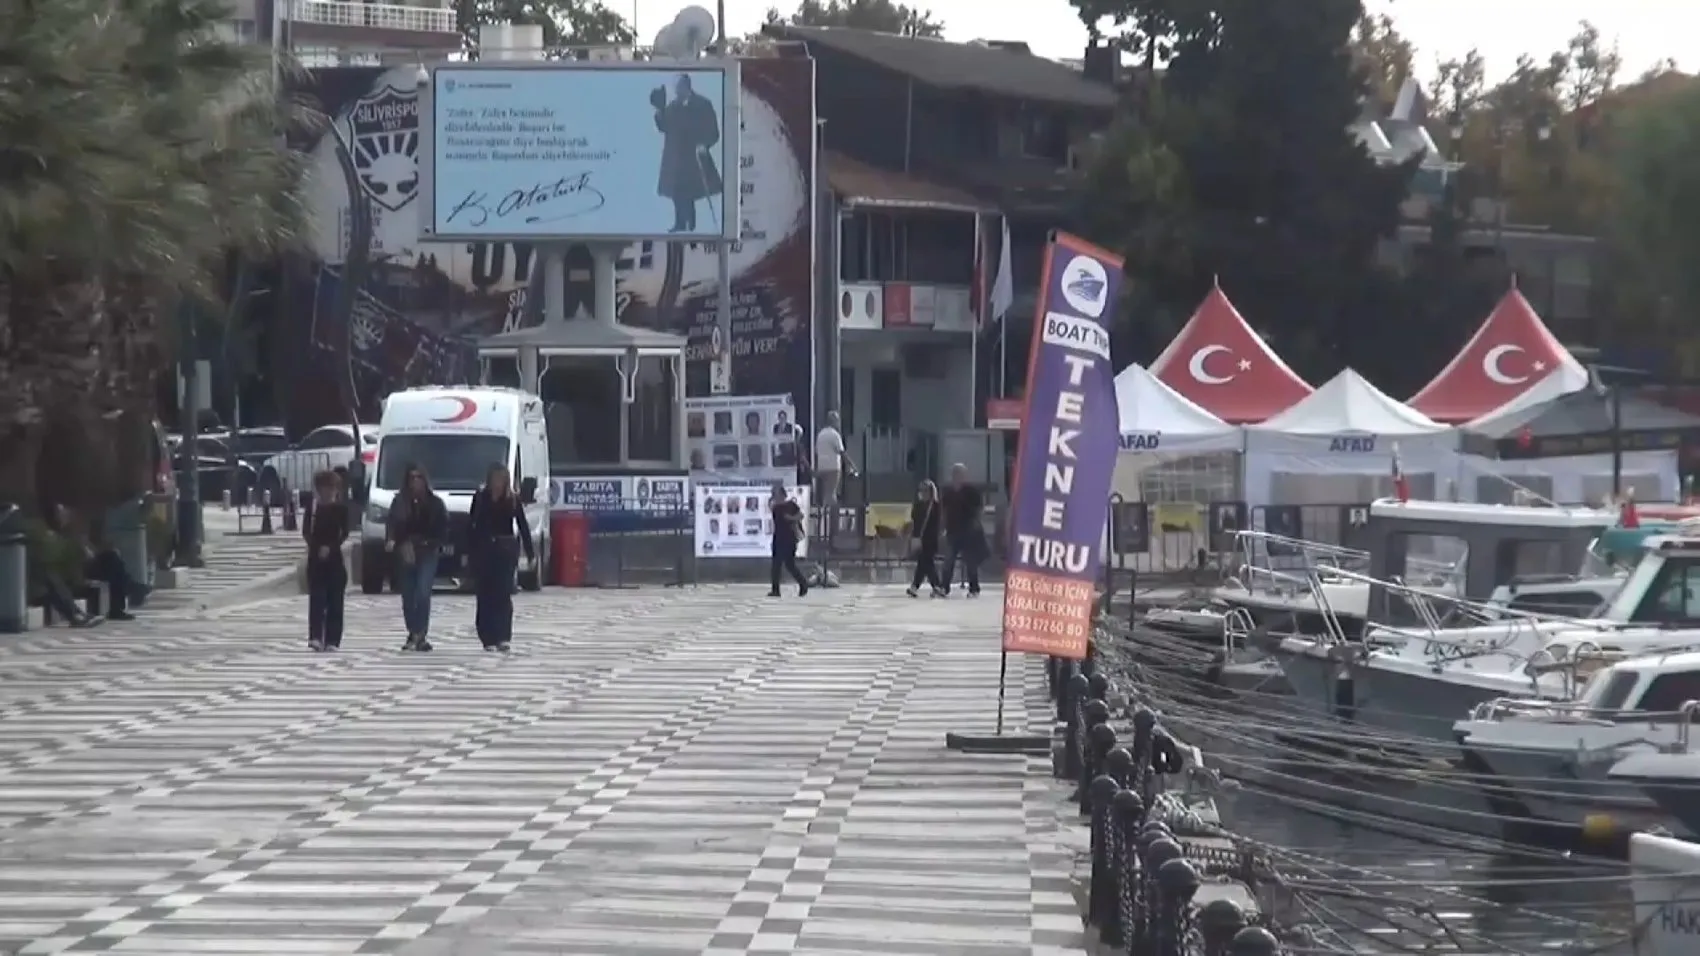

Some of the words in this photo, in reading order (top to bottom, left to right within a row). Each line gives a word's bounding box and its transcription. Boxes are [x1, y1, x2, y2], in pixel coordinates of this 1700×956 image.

[357, 100, 418, 123] SİLİVRİSPO
[1048, 319, 1090, 343] BOAT
[1042, 354, 1096, 531] TEKNE
[1328, 437, 1375, 453] AFAD
[1017, 533, 1090, 573] TURU
